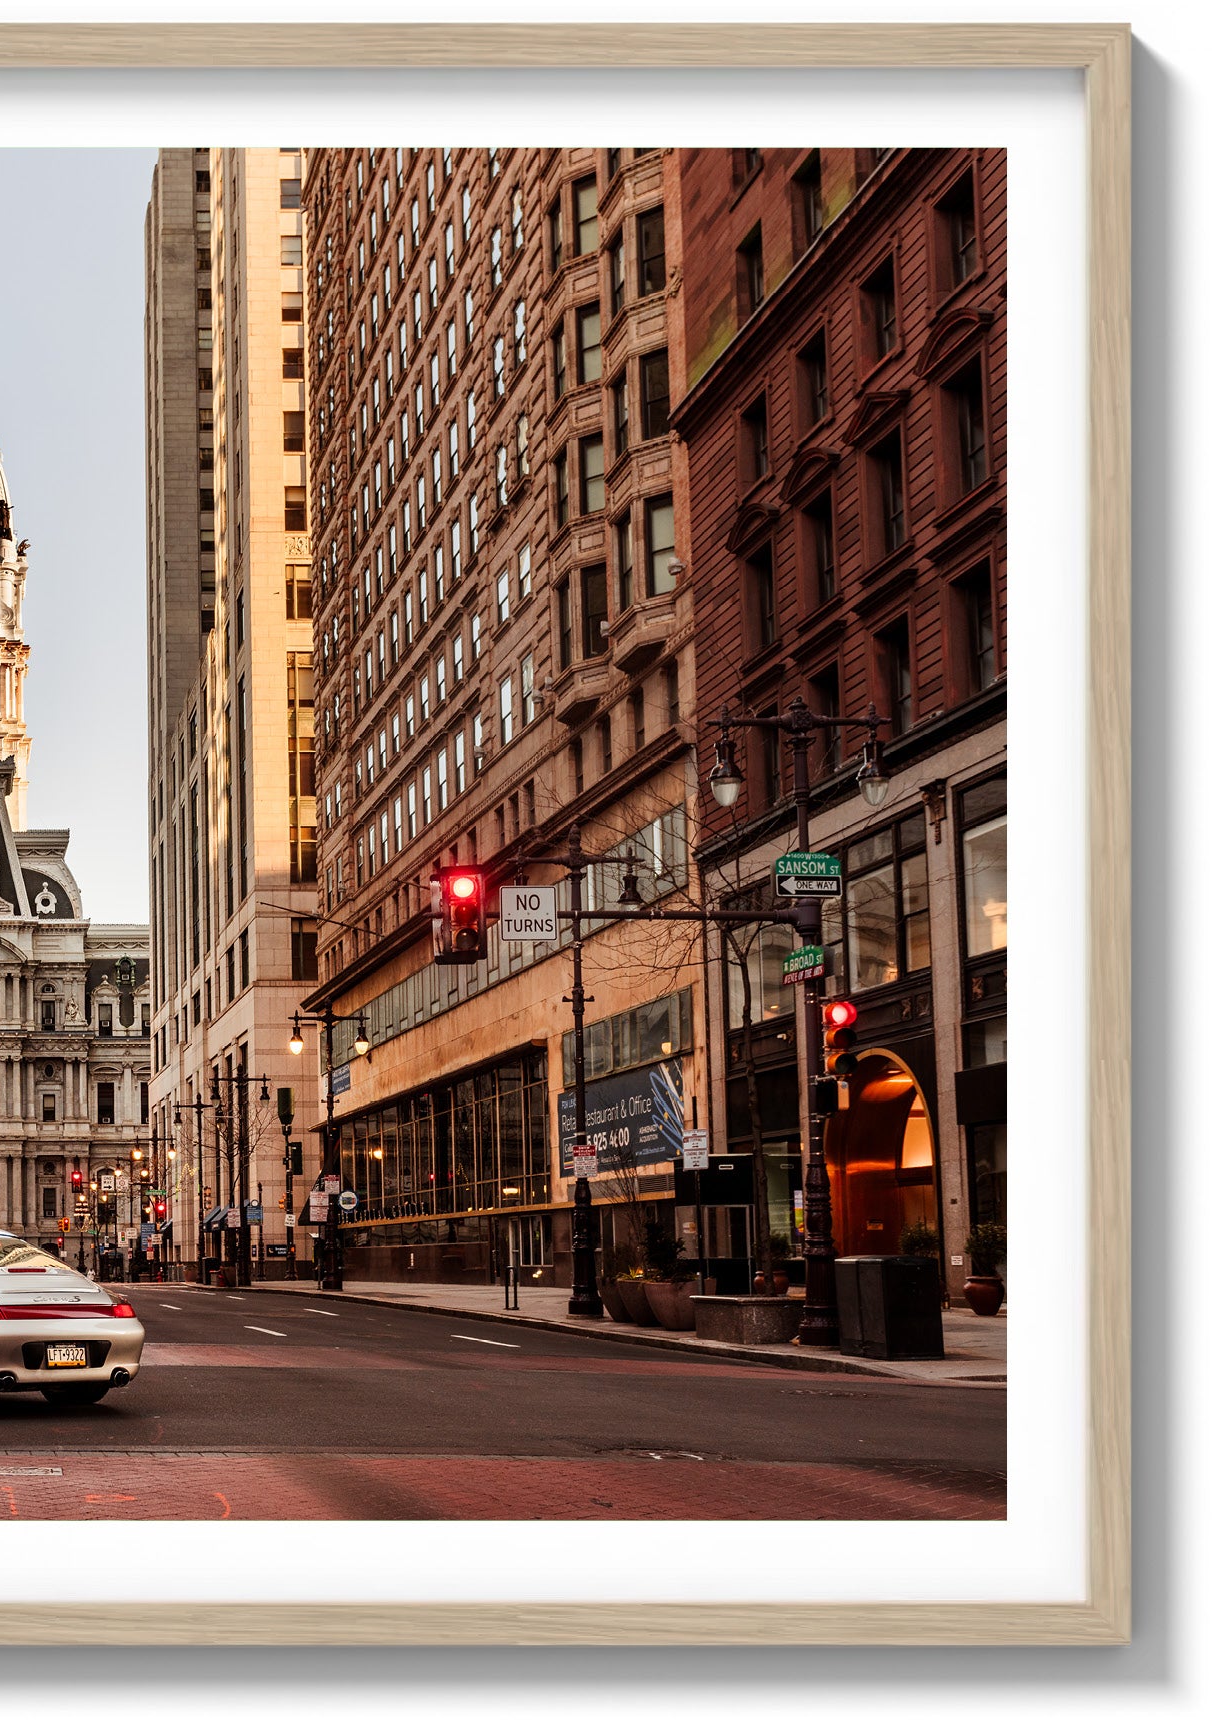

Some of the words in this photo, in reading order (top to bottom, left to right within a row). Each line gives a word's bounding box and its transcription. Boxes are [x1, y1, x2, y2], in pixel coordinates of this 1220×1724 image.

[778, 861, 826, 874] SANSOM
[829, 865, 839, 875] ST
[796, 881, 814, 889] ONE
[816, 881, 834, 889] WAY
[516, 894, 540, 911] NO
[504, 919, 553, 932] TURNS
[789, 953, 815, 972] BROAD
[815, 954, 823, 964] ST
[561, 1114, 577, 1133] Reta
[584, 1104, 619, 1128] estaurant
[620, 1099, 627, 1119] &
[628, 1095, 652, 1117] Office
